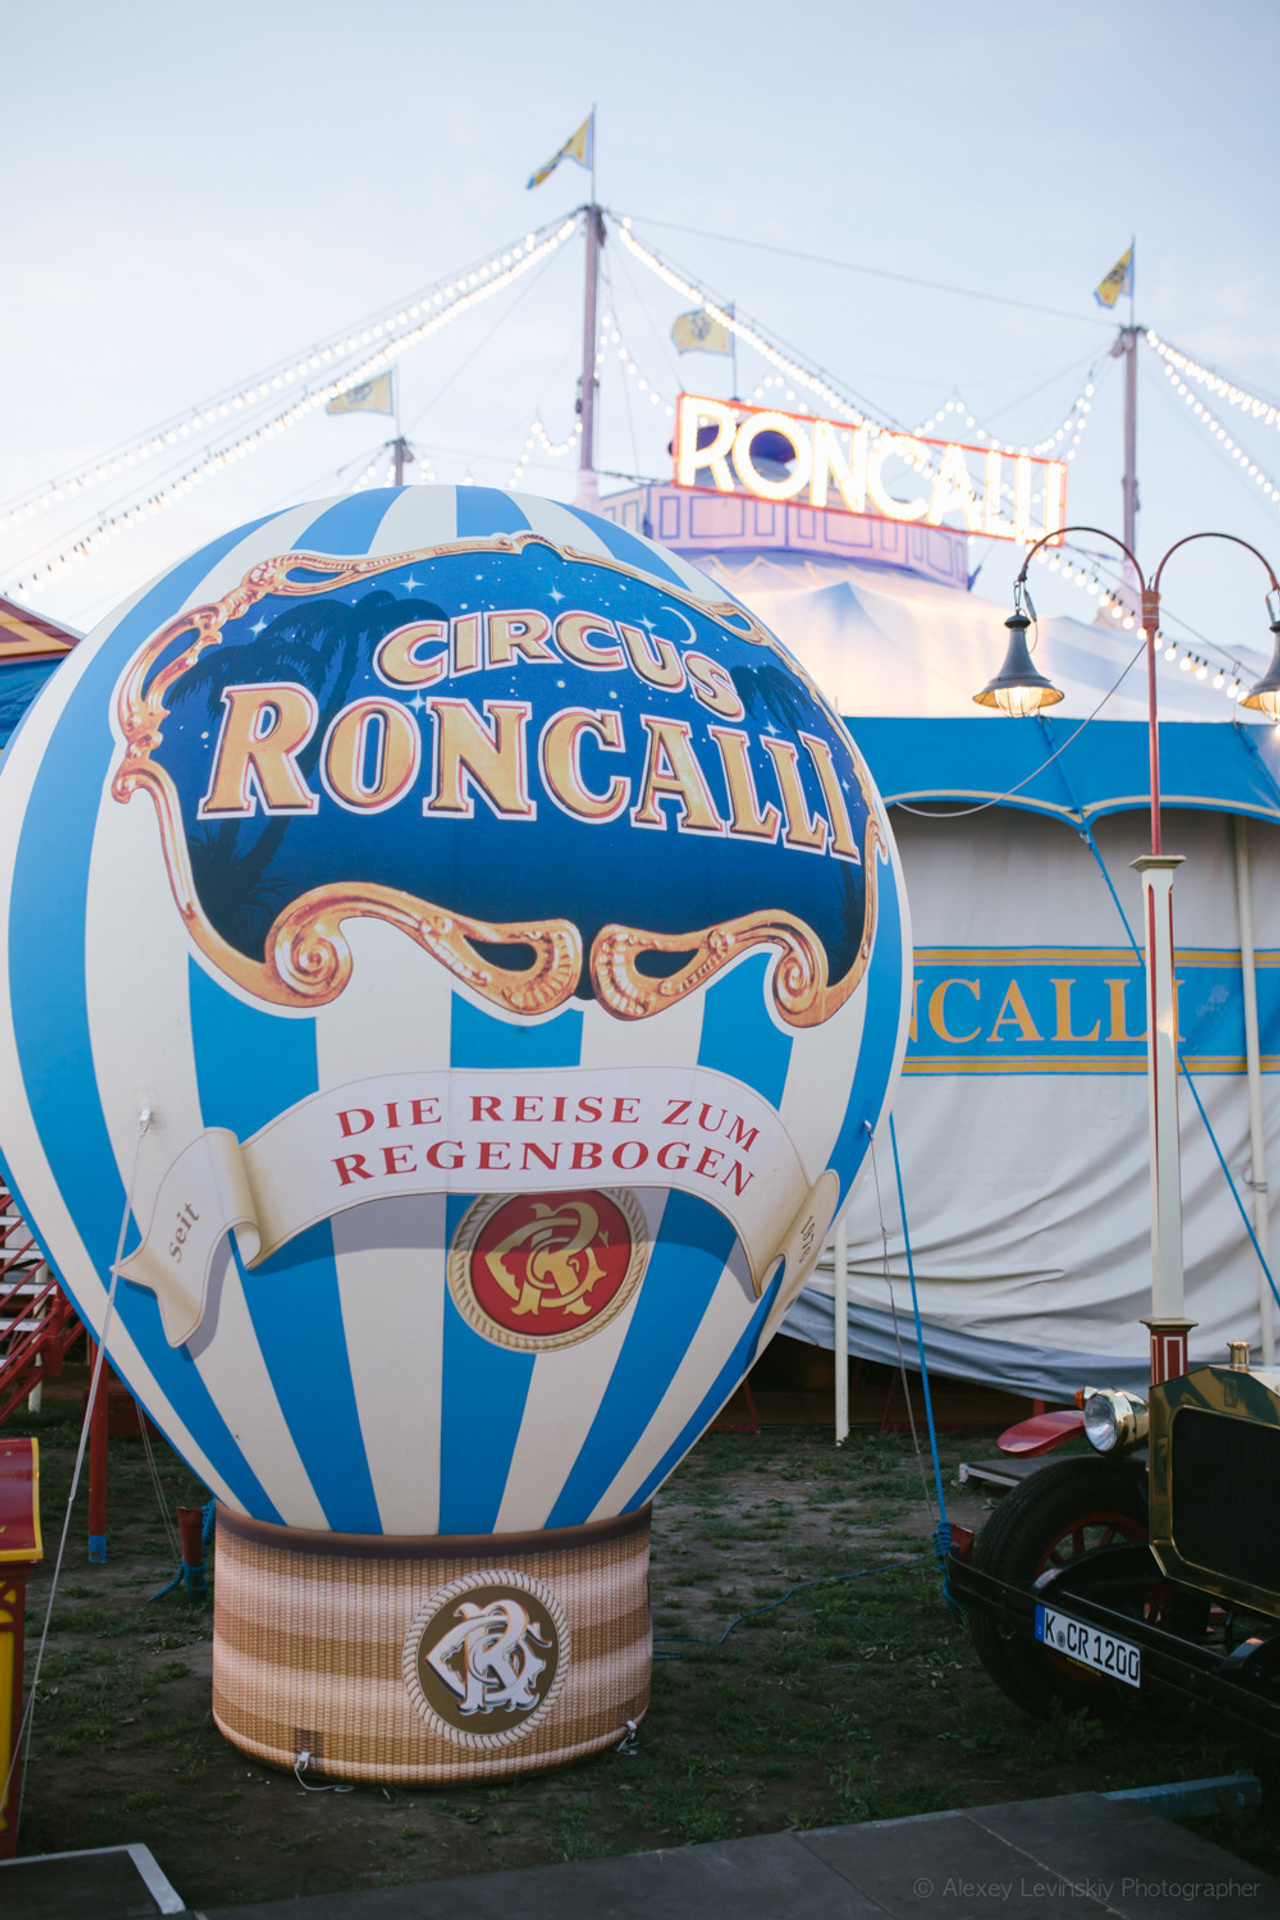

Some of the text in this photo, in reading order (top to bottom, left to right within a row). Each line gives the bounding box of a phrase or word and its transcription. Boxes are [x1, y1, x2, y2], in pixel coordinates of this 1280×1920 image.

[678, 394, 1062, 546] RONCALLI
[373, 609, 745, 722] CIRCUS
[197, 682, 861, 865] RONCALLI
[908, 978, 1187, 1043] CALL
[335, 1095, 761, 1153] DIE REISE ZUM
[331, 1140, 755, 1197] REGENBOGEN
[168, 1202, 200, 1263] seit
[1045, 1612, 1056, 1643] K
[1067, 1622, 1089, 1659] CR
[1093, 1635, 1140, 1682] 1200
